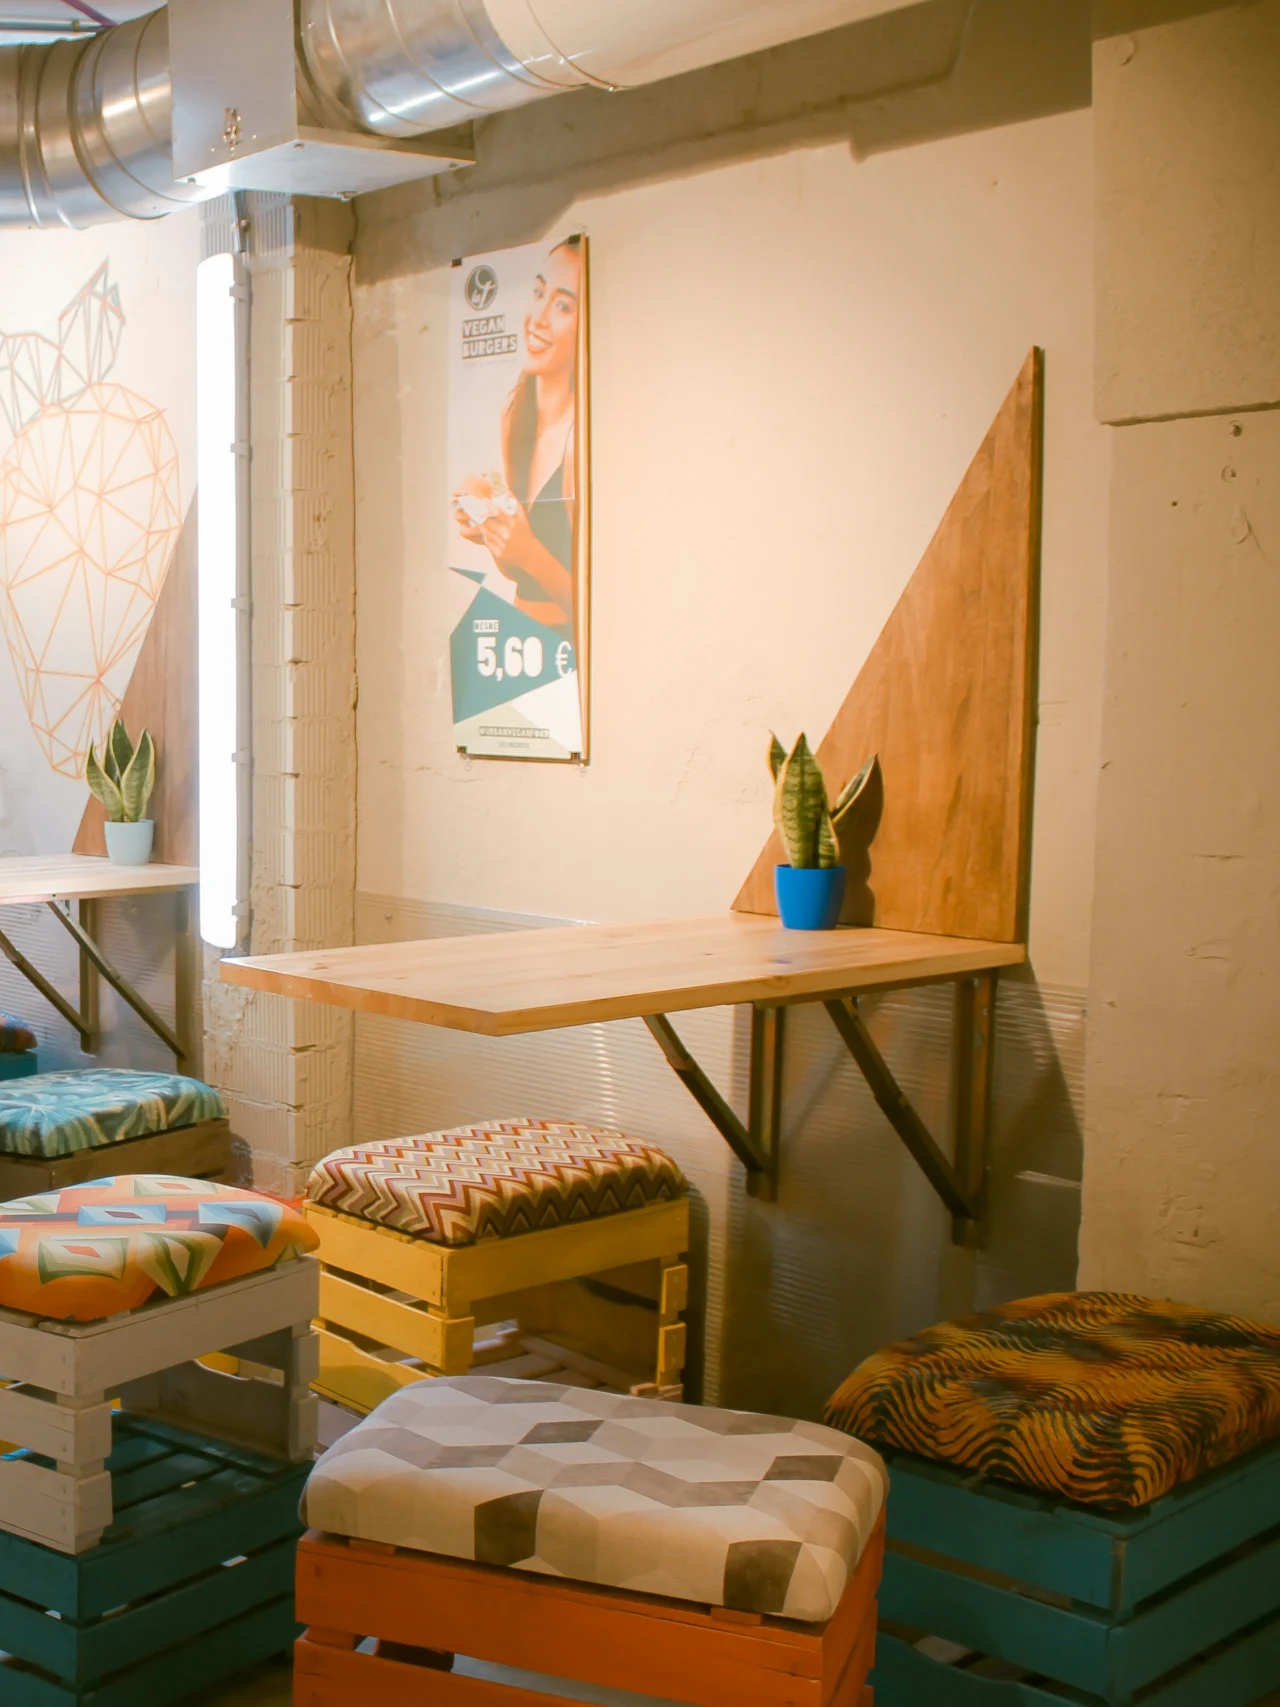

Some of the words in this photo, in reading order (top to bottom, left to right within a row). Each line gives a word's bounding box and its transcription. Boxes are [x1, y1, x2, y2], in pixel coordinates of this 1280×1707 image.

[463, 316, 506, 337] VEGAN
[463, 336, 517, 357] BURGERS
[477, 636, 543, 682] 5,60
[555, 640, 572, 677] €
